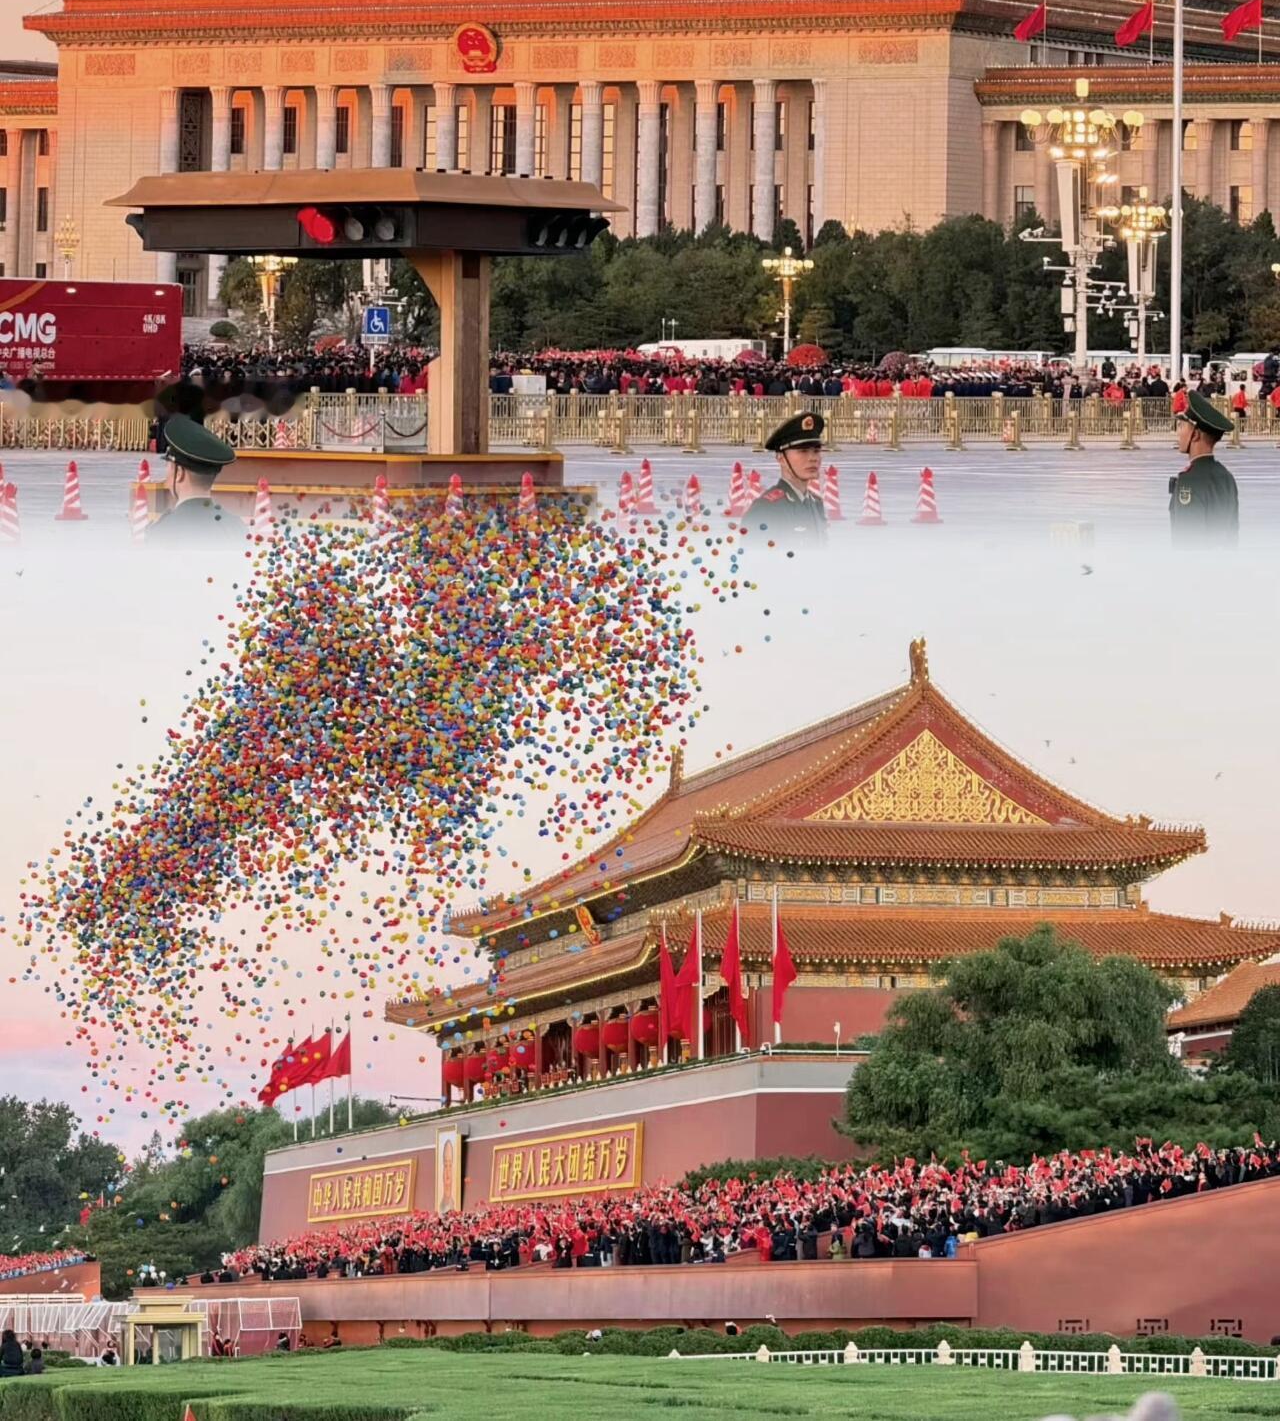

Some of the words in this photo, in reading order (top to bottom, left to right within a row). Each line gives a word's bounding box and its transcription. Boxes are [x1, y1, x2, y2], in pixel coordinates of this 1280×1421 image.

[0, 311, 56, 344] CMG
[0, 346, 56, 359] 央广播电视总台
[499, 1136, 628, 1191] 世界人民大团结万岁
[313, 1171, 405, 1214] 中华人民共和国万岁
